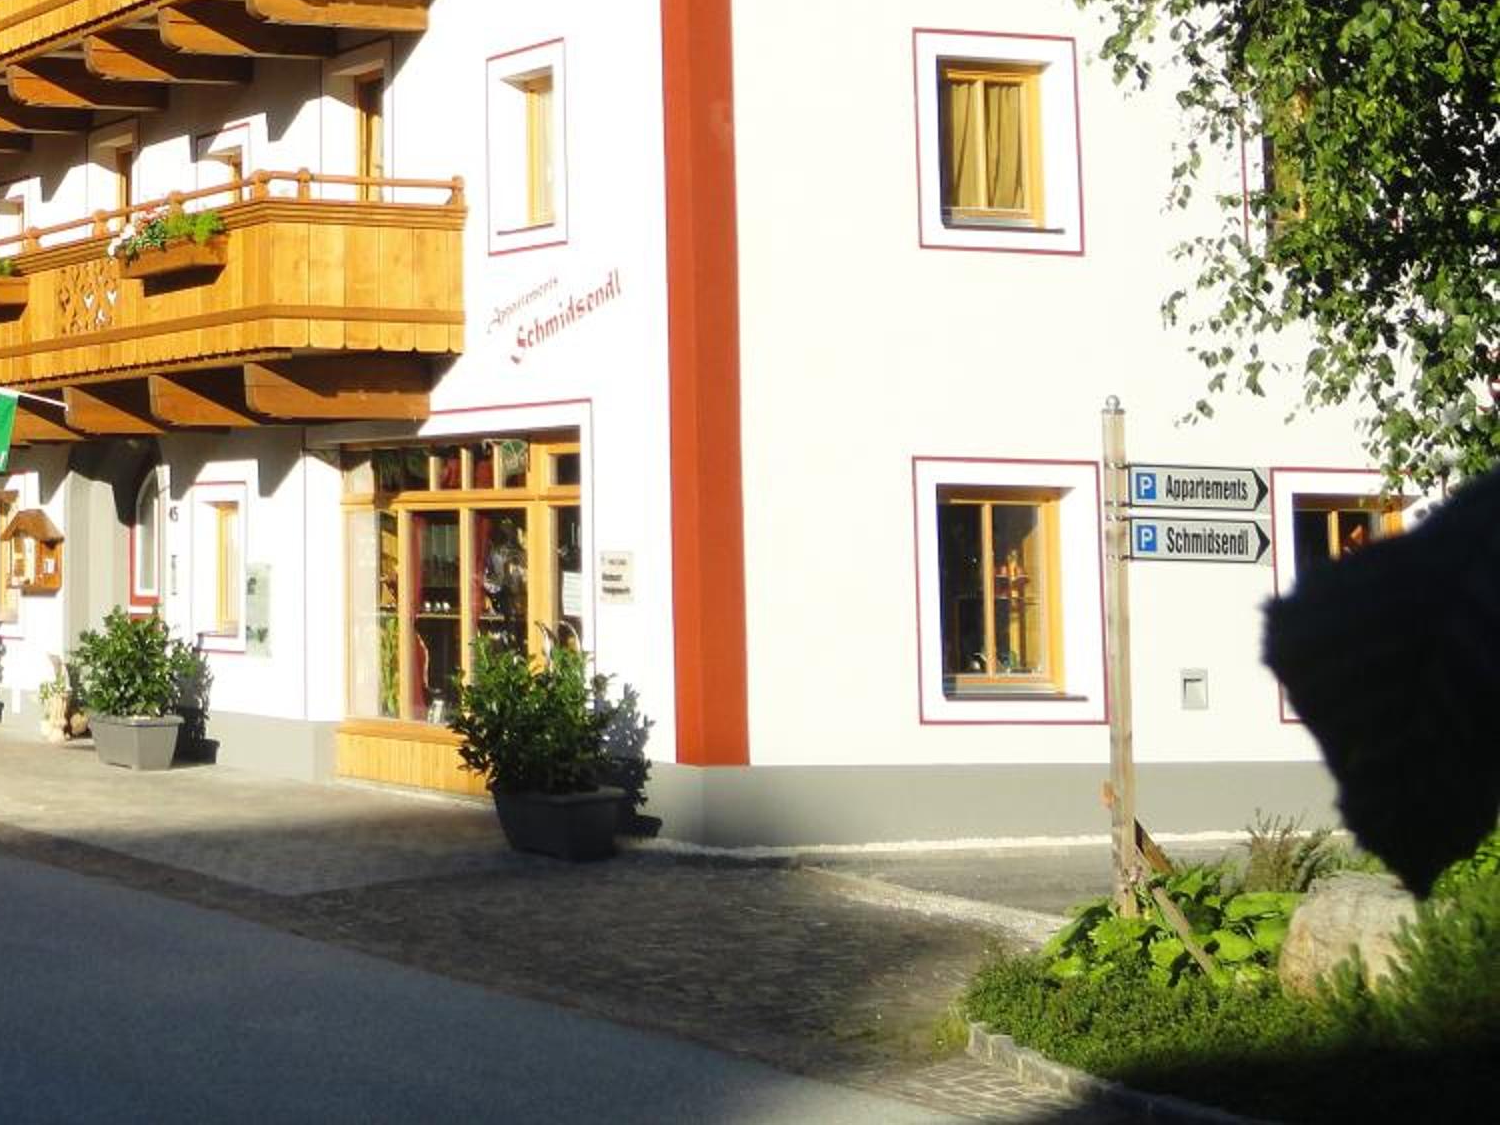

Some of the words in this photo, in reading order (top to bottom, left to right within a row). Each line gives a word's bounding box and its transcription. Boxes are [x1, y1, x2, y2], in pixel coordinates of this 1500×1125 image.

[510, 268, 622, 364] Schmidsendl
[1165, 474, 1249, 502] Appartements
[1166, 527, 1249, 556] Schmidsendl
